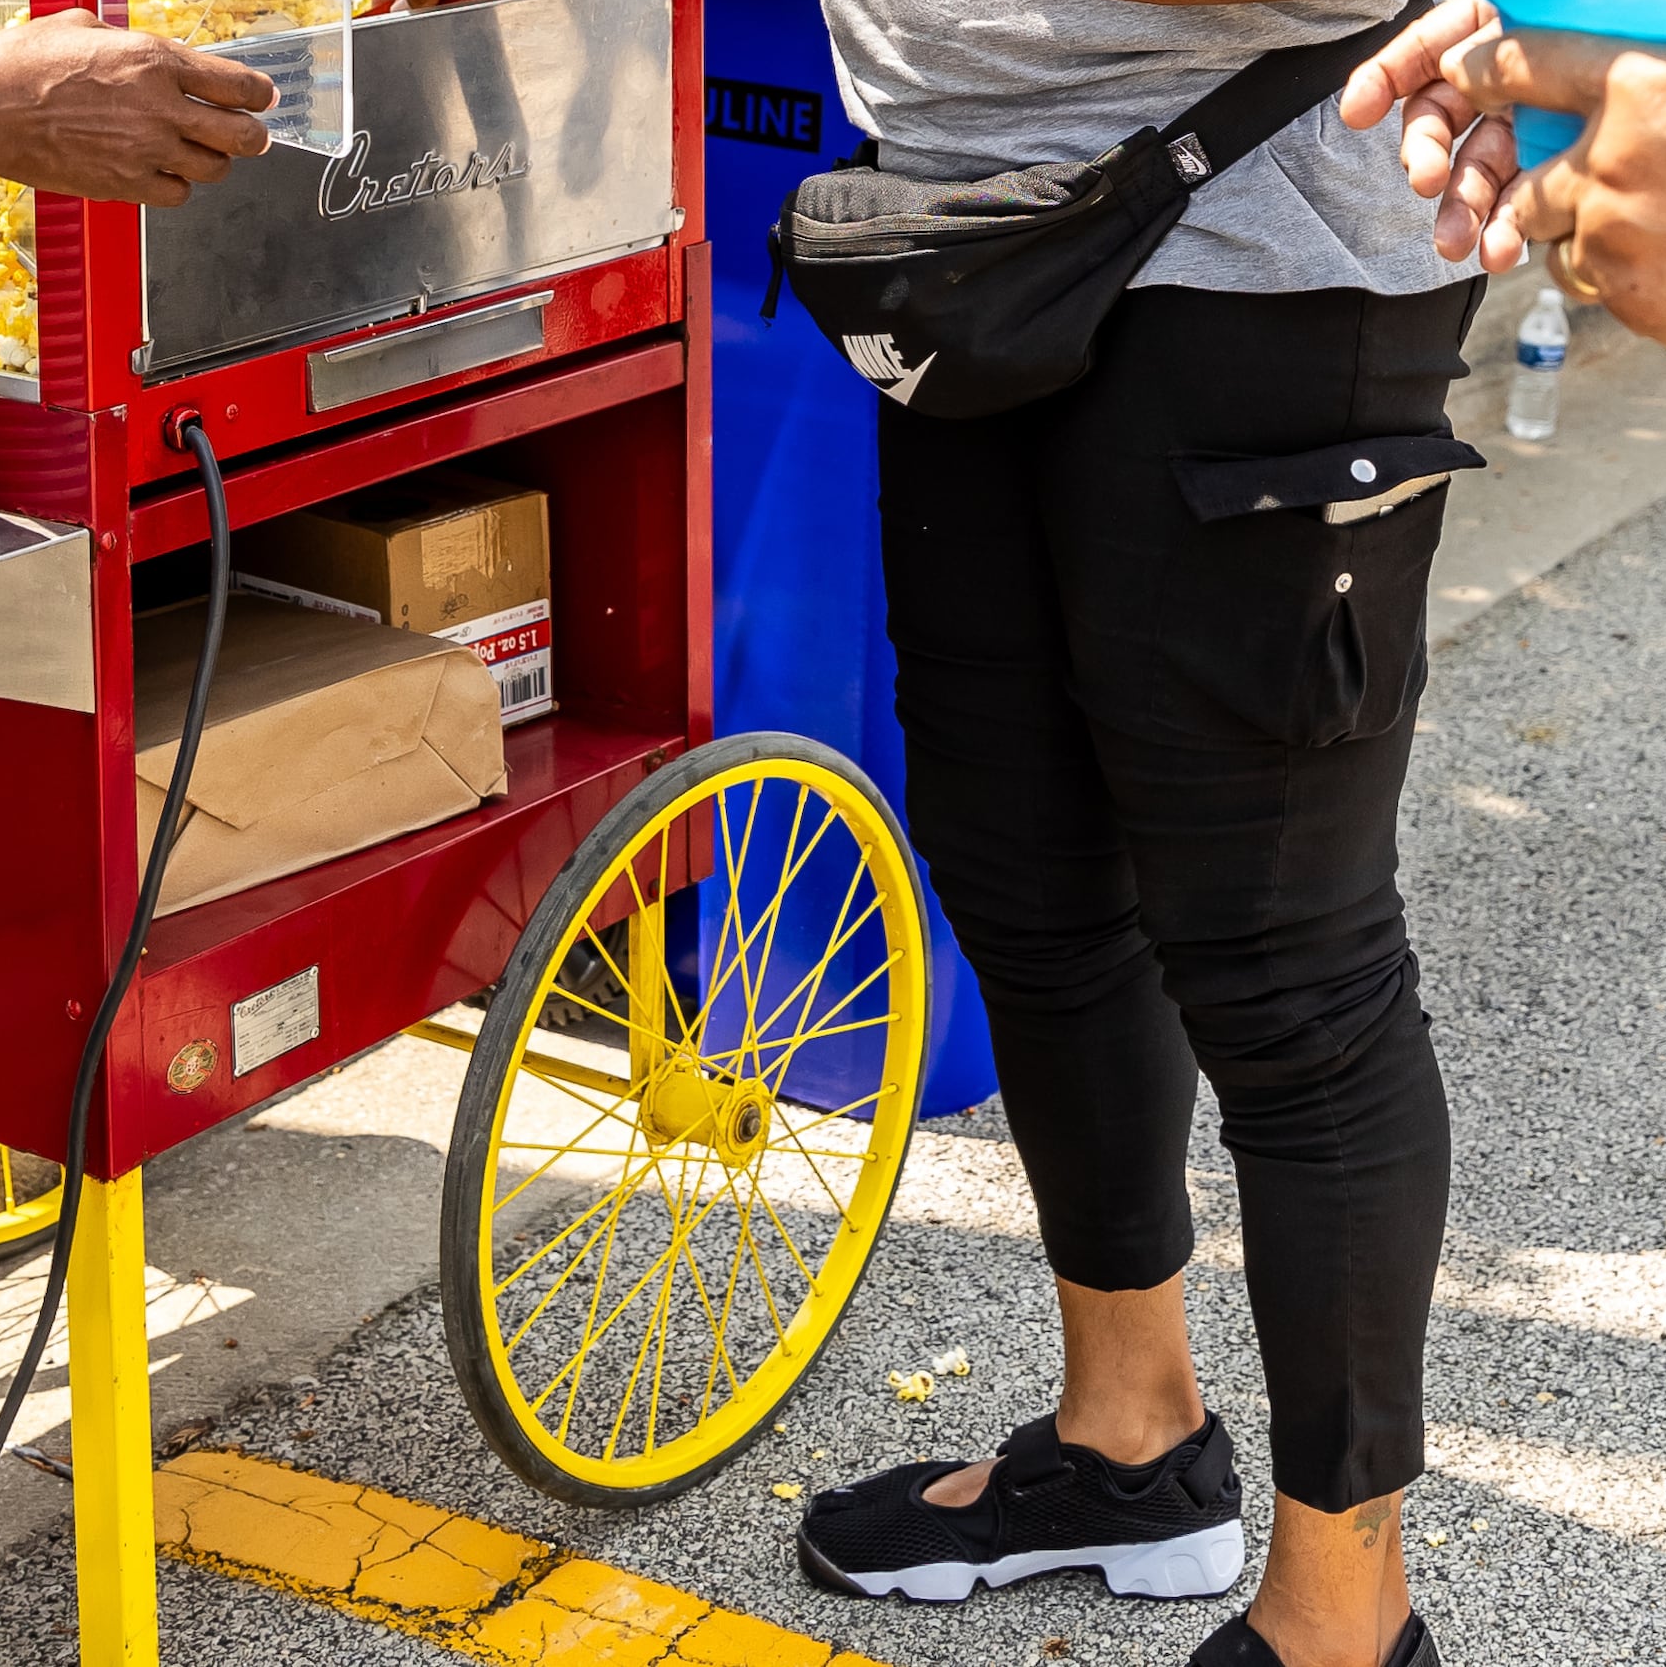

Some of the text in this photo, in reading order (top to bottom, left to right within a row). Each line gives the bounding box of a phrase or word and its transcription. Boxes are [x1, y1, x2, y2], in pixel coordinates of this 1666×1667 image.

[317, 129, 532, 221] Cretors
[842, 333, 911, 379] NIKE
[497, 636, 516, 652] oz.
[518, 629, 537, 651] 1.5
